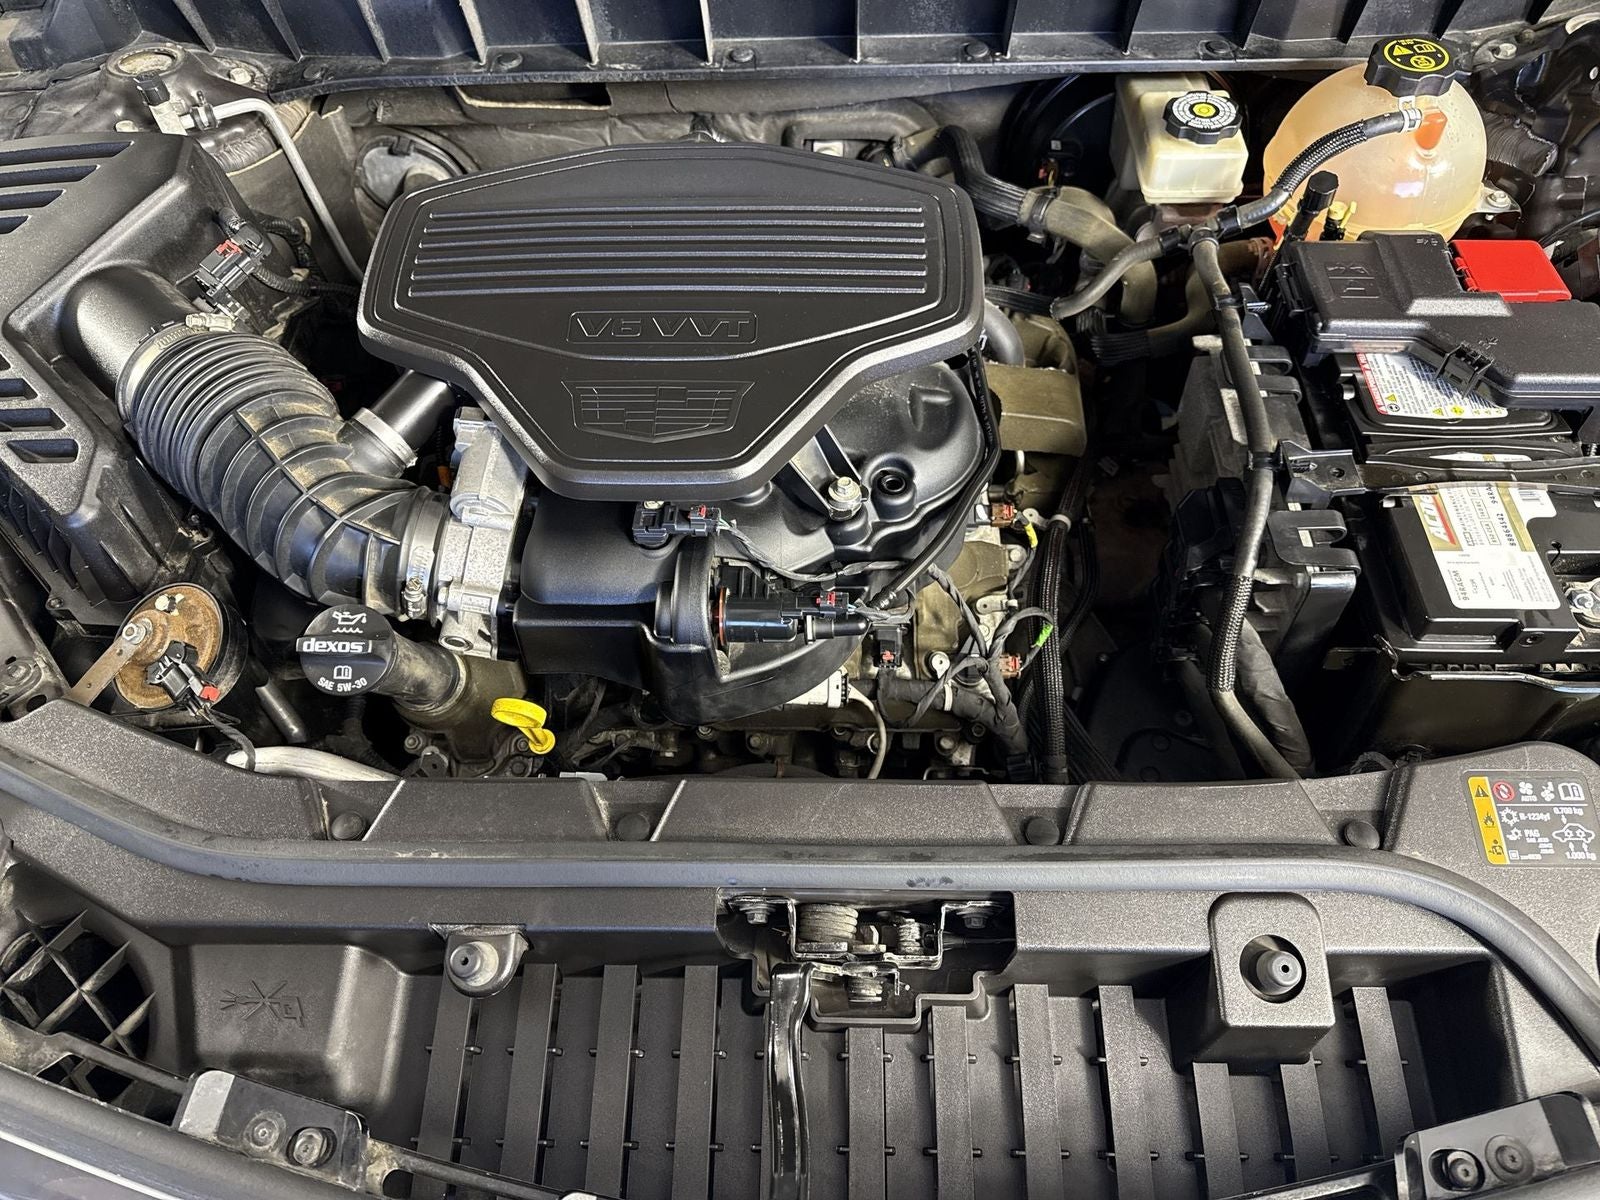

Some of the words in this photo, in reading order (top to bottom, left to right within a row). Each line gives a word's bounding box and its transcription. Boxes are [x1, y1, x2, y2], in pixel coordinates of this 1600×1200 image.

[577, 317, 642, 337] V6
[652, 317, 750, 337] VVT
[1486, 485, 1498, 504] 94RA
[1418, 495, 1450, 543] ACDe
[303, 638, 365, 653] dexos
[318, 677, 335, 691] SAE
[337, 678, 368, 692] 5W-30
